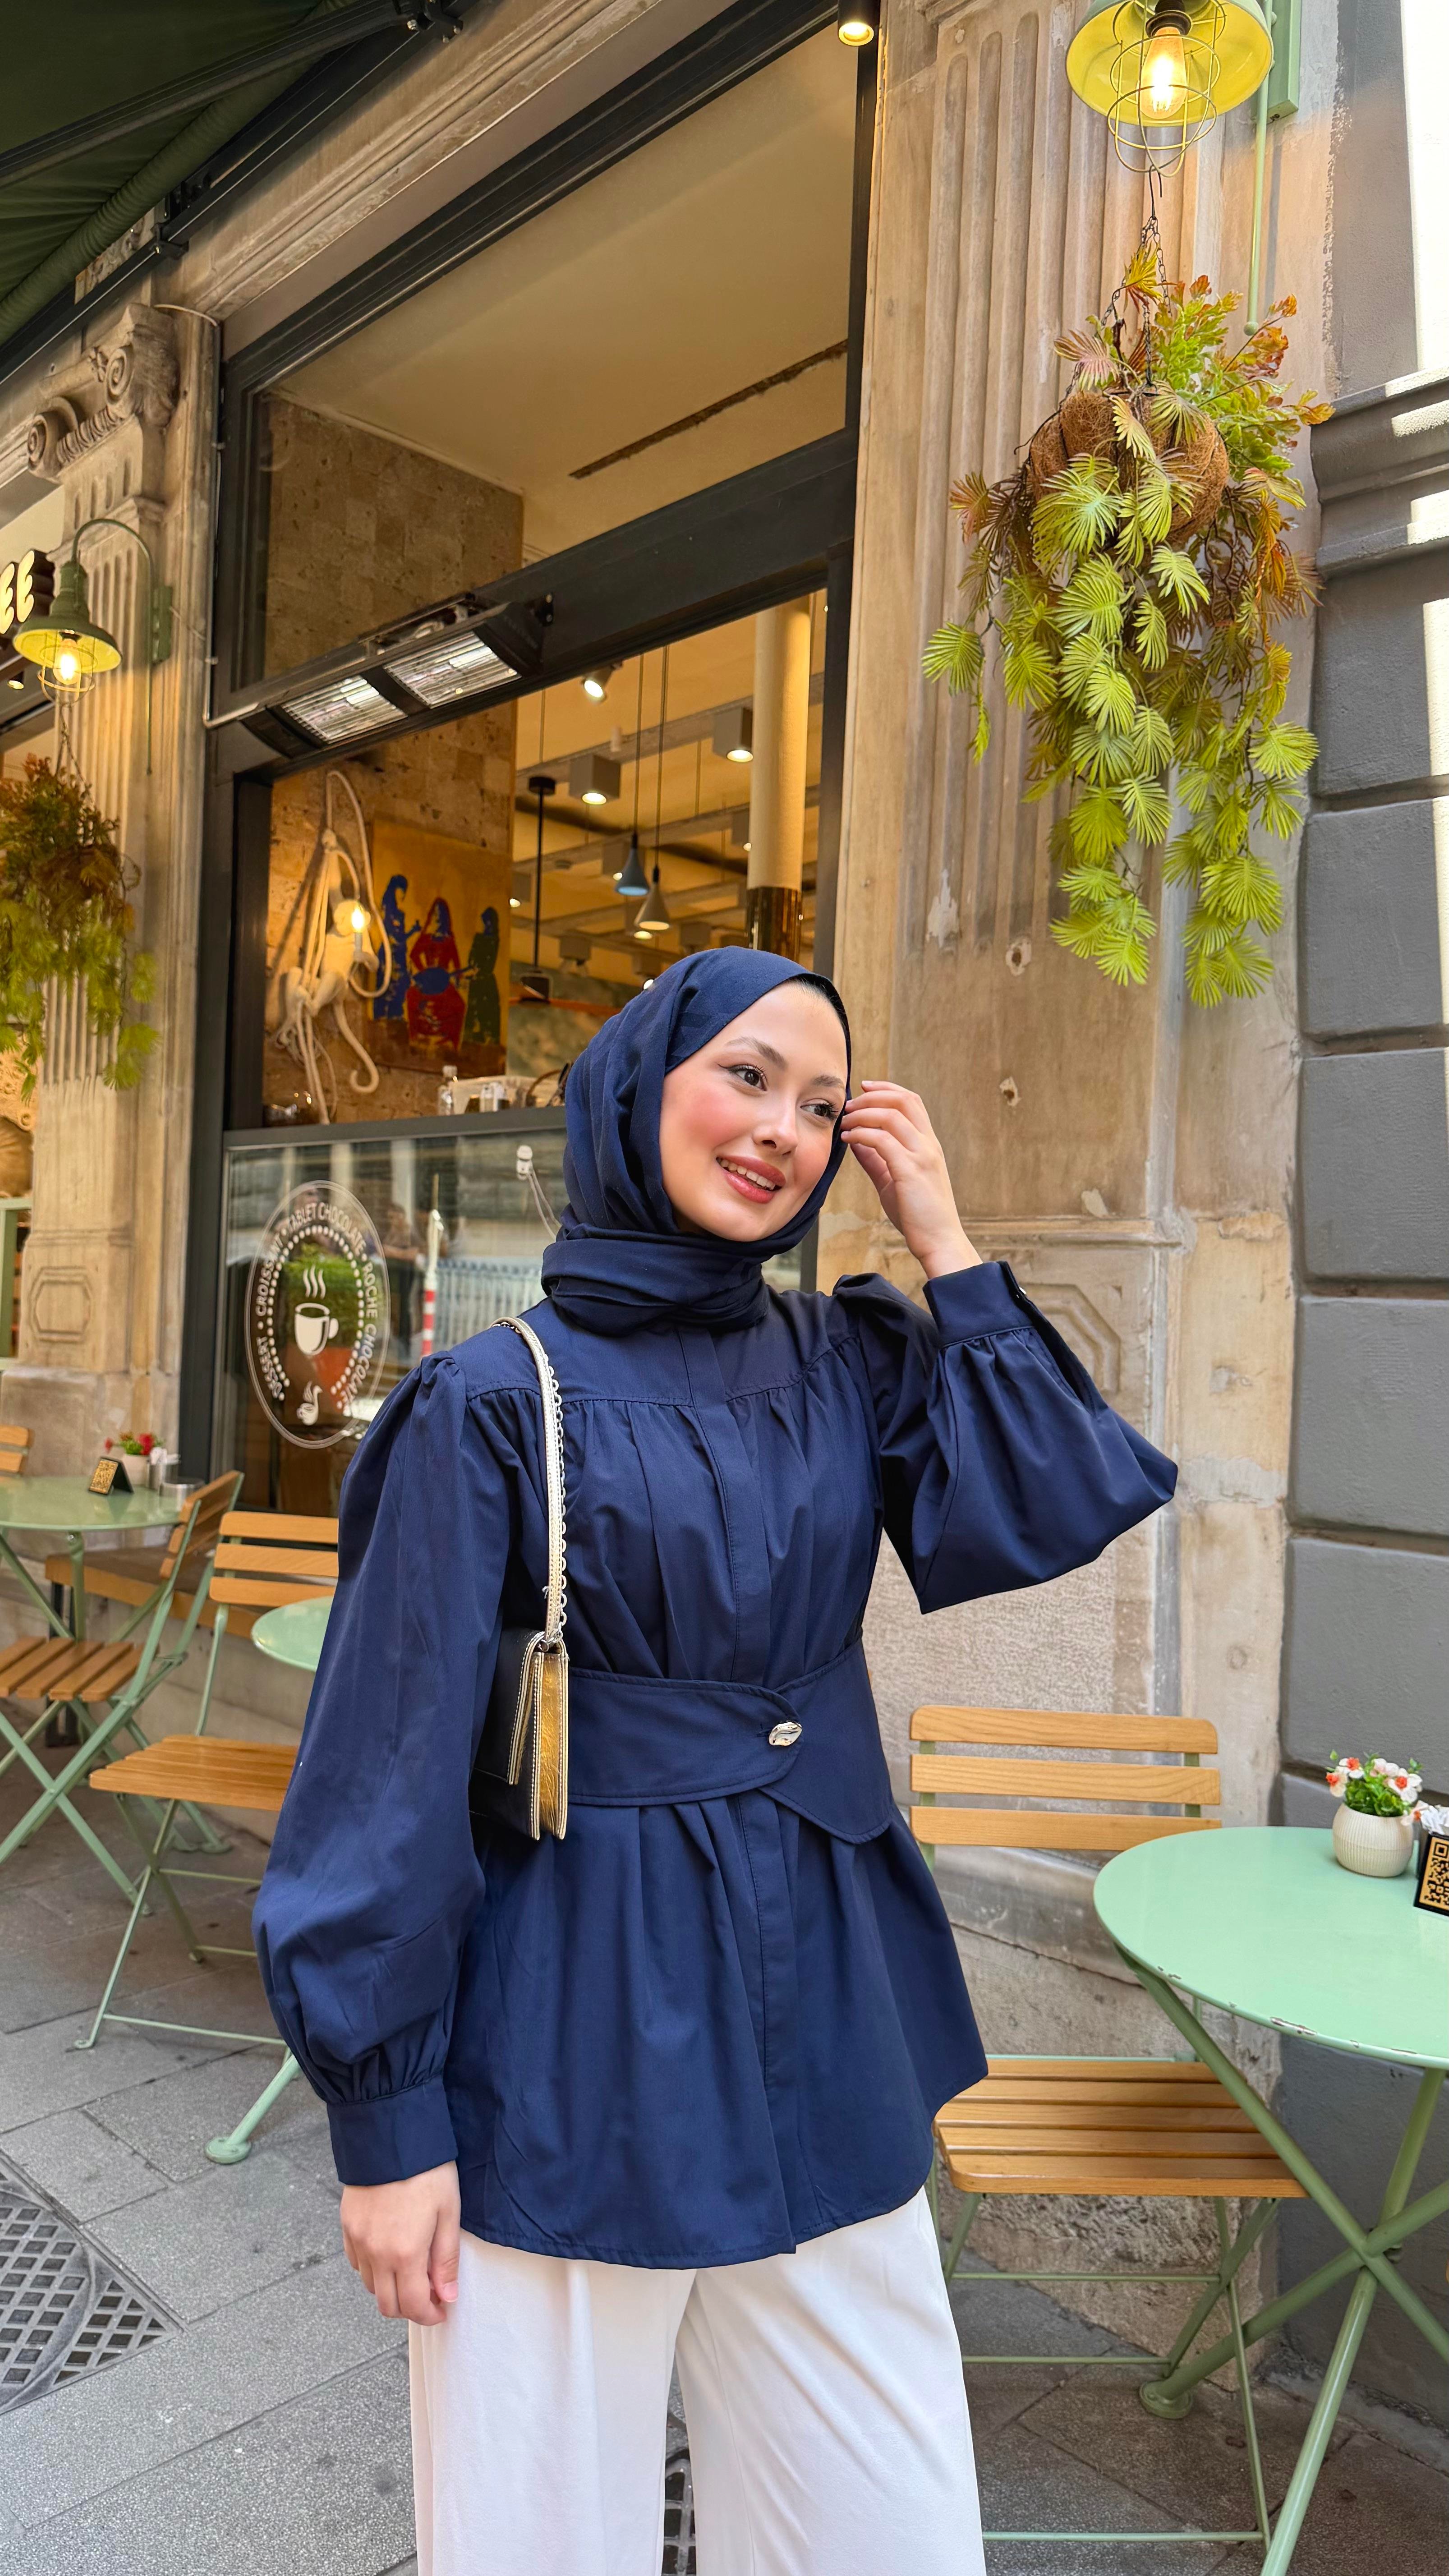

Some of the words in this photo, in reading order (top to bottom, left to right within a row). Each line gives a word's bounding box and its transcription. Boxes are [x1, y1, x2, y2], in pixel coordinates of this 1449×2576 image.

[287, 1202, 317, 1233] TABLET
[317, 1202, 367, 1257] CHOCOLATE
[255, 1233, 284, 1316] CROISSANT
[362, 1262, 378, 1319] ROCHE
[340, 1323, 377, 1408] CHOCOLATE
